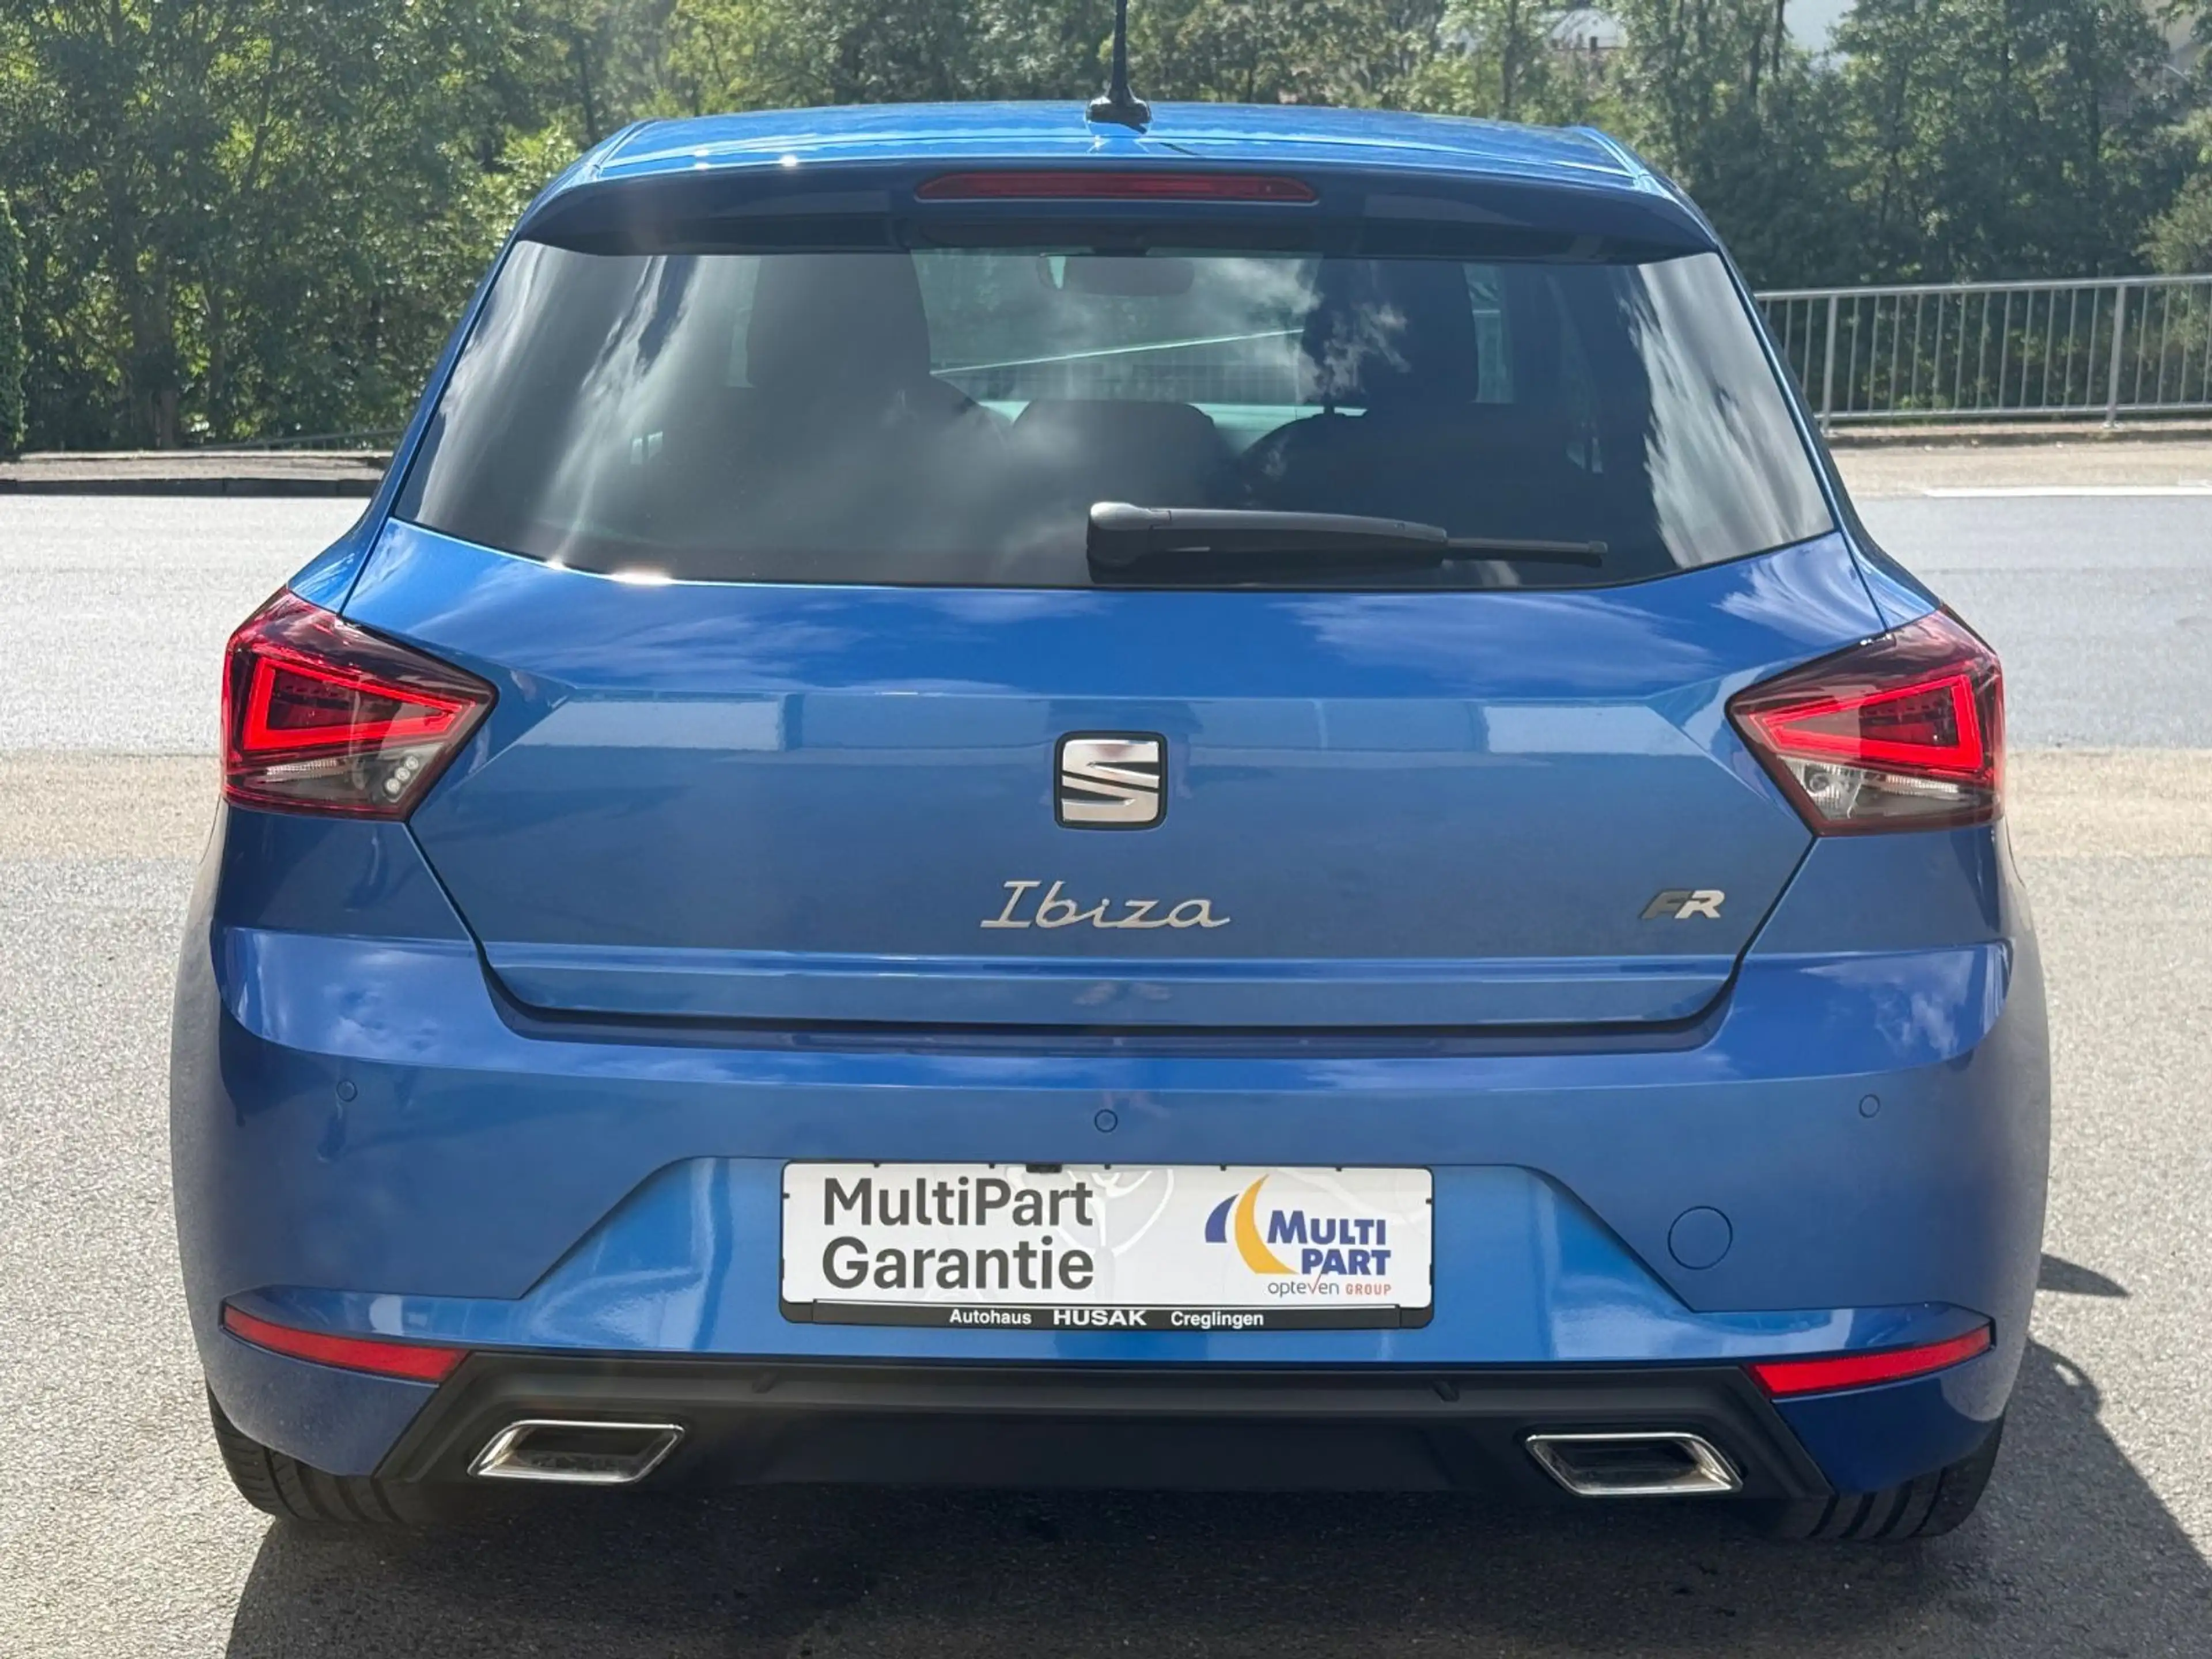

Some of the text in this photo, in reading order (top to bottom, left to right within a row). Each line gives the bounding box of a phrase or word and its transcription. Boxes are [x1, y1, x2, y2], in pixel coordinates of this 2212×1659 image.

[980, 880, 1230, 929] Ibiza
[1641, 889, 1725, 919] FR
[824, 1176, 1093, 1226] MultiPart
[1268, 1210, 1386, 1245] MULTI
[823, 1235, 1094, 1290] Garantie
[1301, 1248, 1391, 1275] PART
[1268, 1274, 1391, 1297] opteven GROUP
[950, 1309, 1264, 1329] Autohaus HUSAK Creglingen
